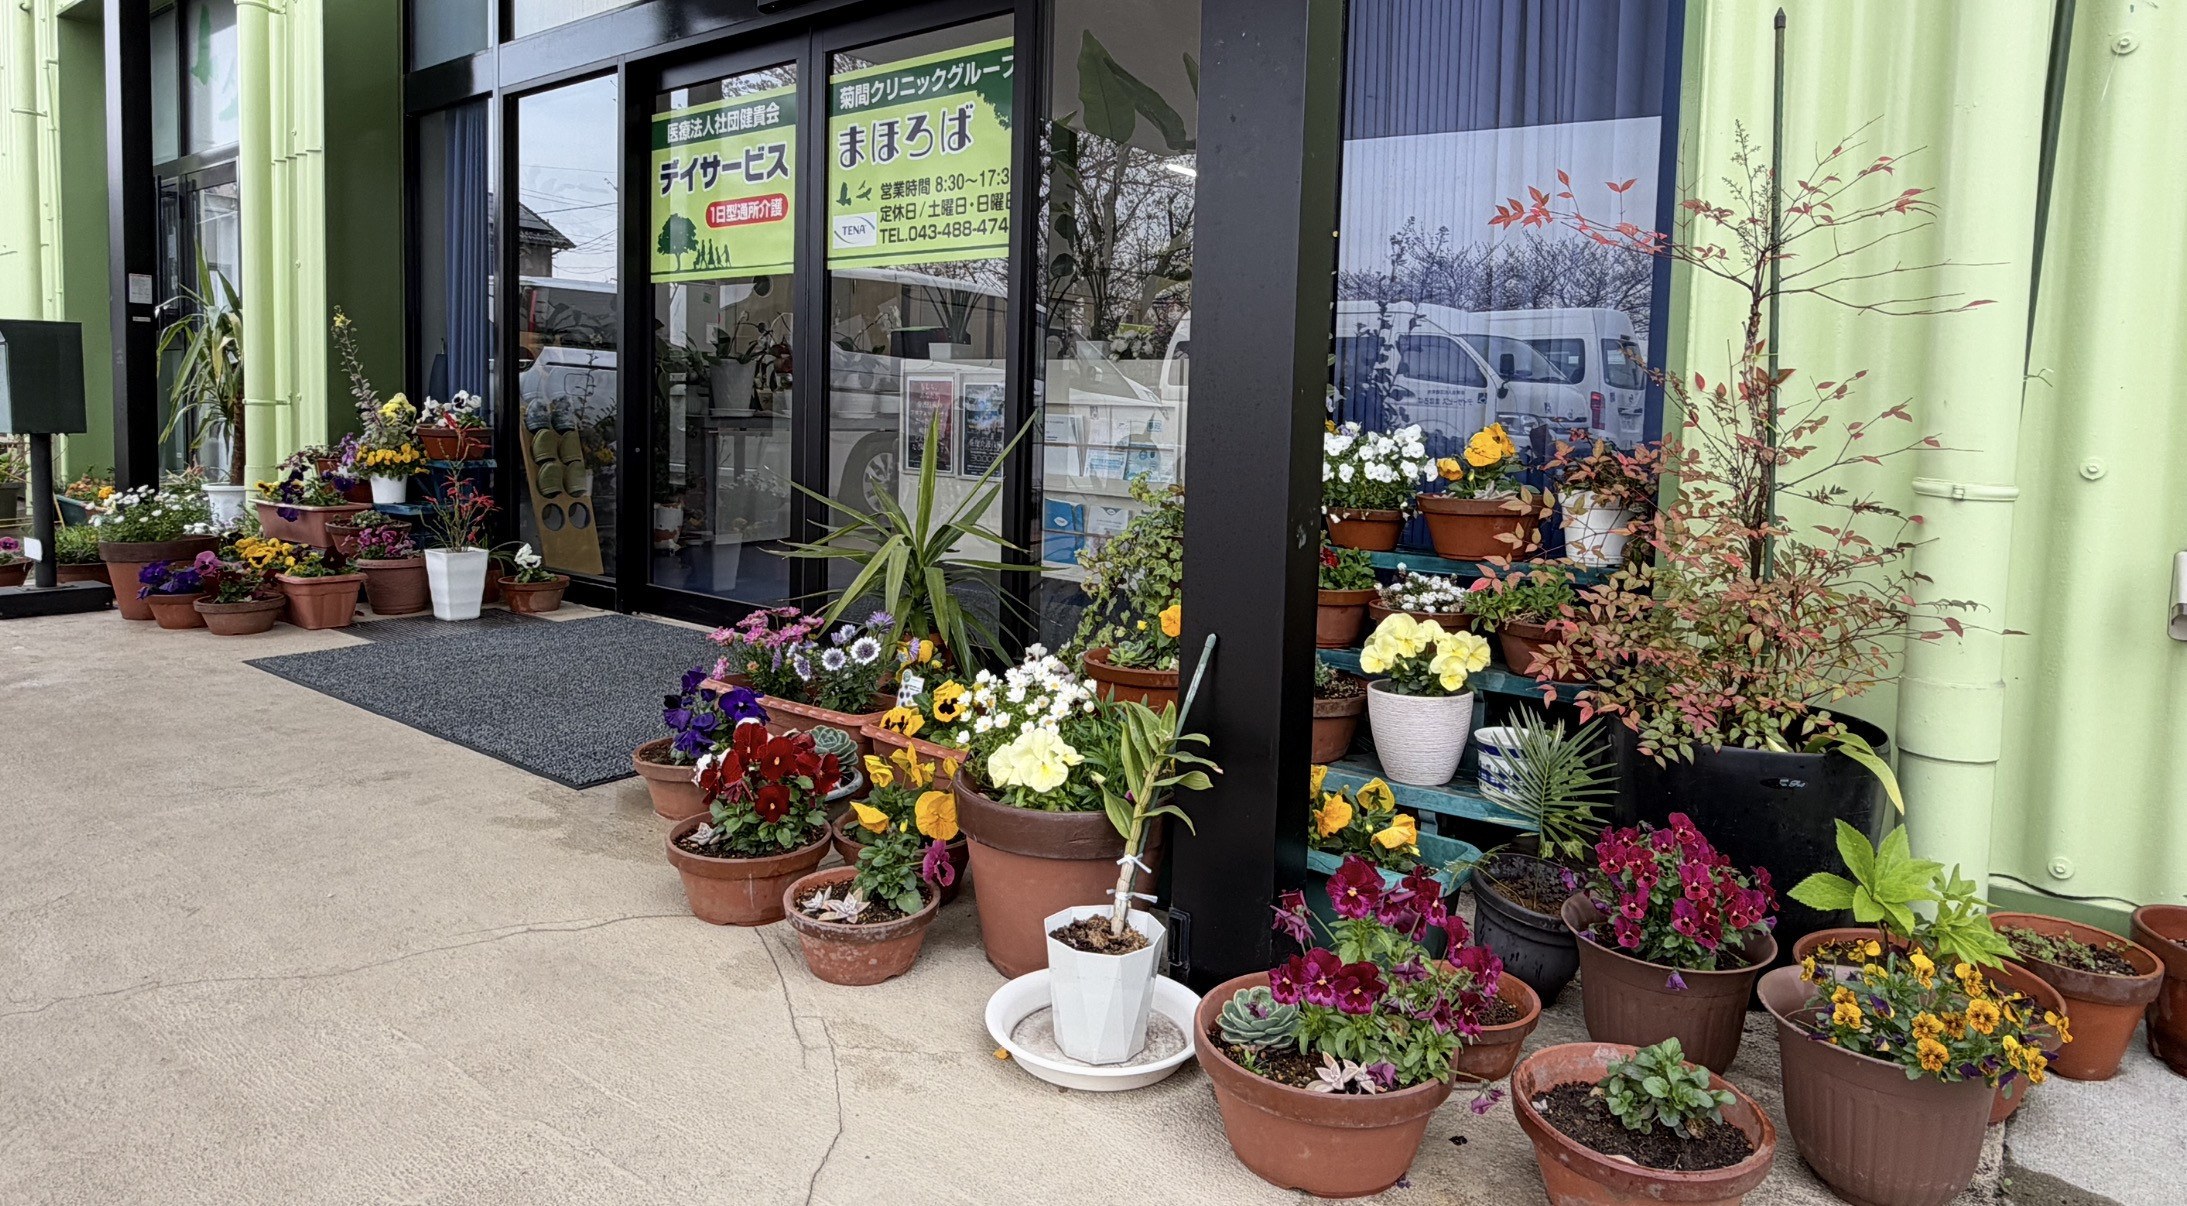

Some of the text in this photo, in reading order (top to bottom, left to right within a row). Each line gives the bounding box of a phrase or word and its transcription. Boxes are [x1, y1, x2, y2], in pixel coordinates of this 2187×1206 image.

[667, 101, 780, 143] 医療法人社団健貴会
[839, 103, 974, 169] まほろば
[660, 142, 790, 196] デイサービス
[880, 177, 931, 200] 営業時間
[710, 197, 783, 223] 1日型通所介護
[842, 225, 866, 236] TENA
